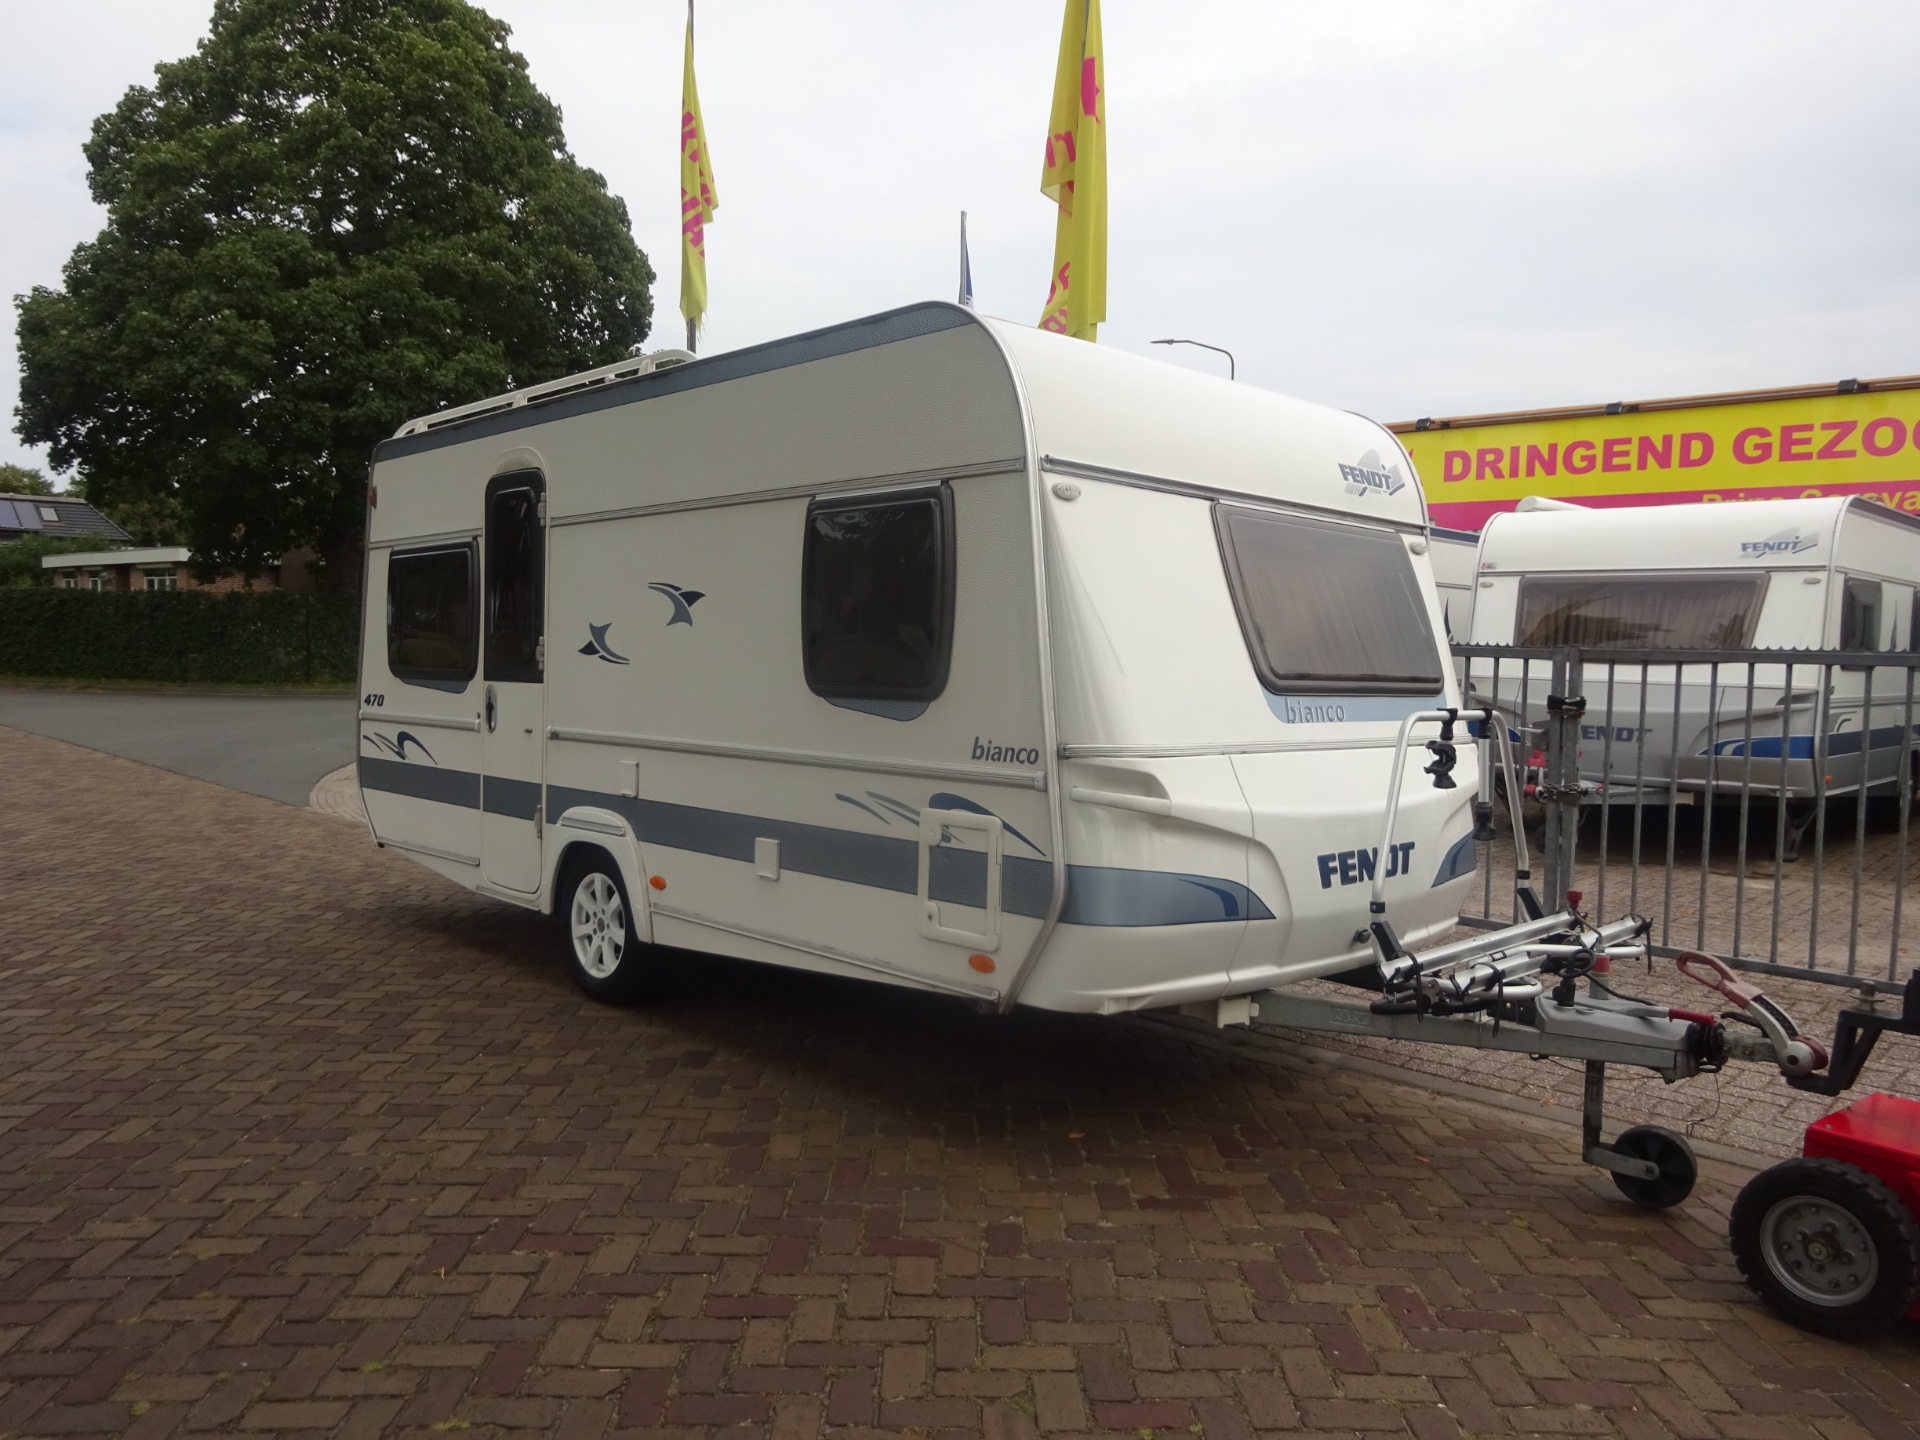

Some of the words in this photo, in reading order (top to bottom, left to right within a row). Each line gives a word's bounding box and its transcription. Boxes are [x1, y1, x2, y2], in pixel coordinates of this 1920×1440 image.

[1443, 431, 1715, 483] DRINGEND
[1732, 416, 1920, 465] GEZO
[1337, 462, 1392, 490] FENDT
[1741, 540, 1803, 552] FENDT
[364, 693, 385, 707] 470
[1284, 697, 1346, 724] bianco
[971, 736, 1039, 765] bianco
